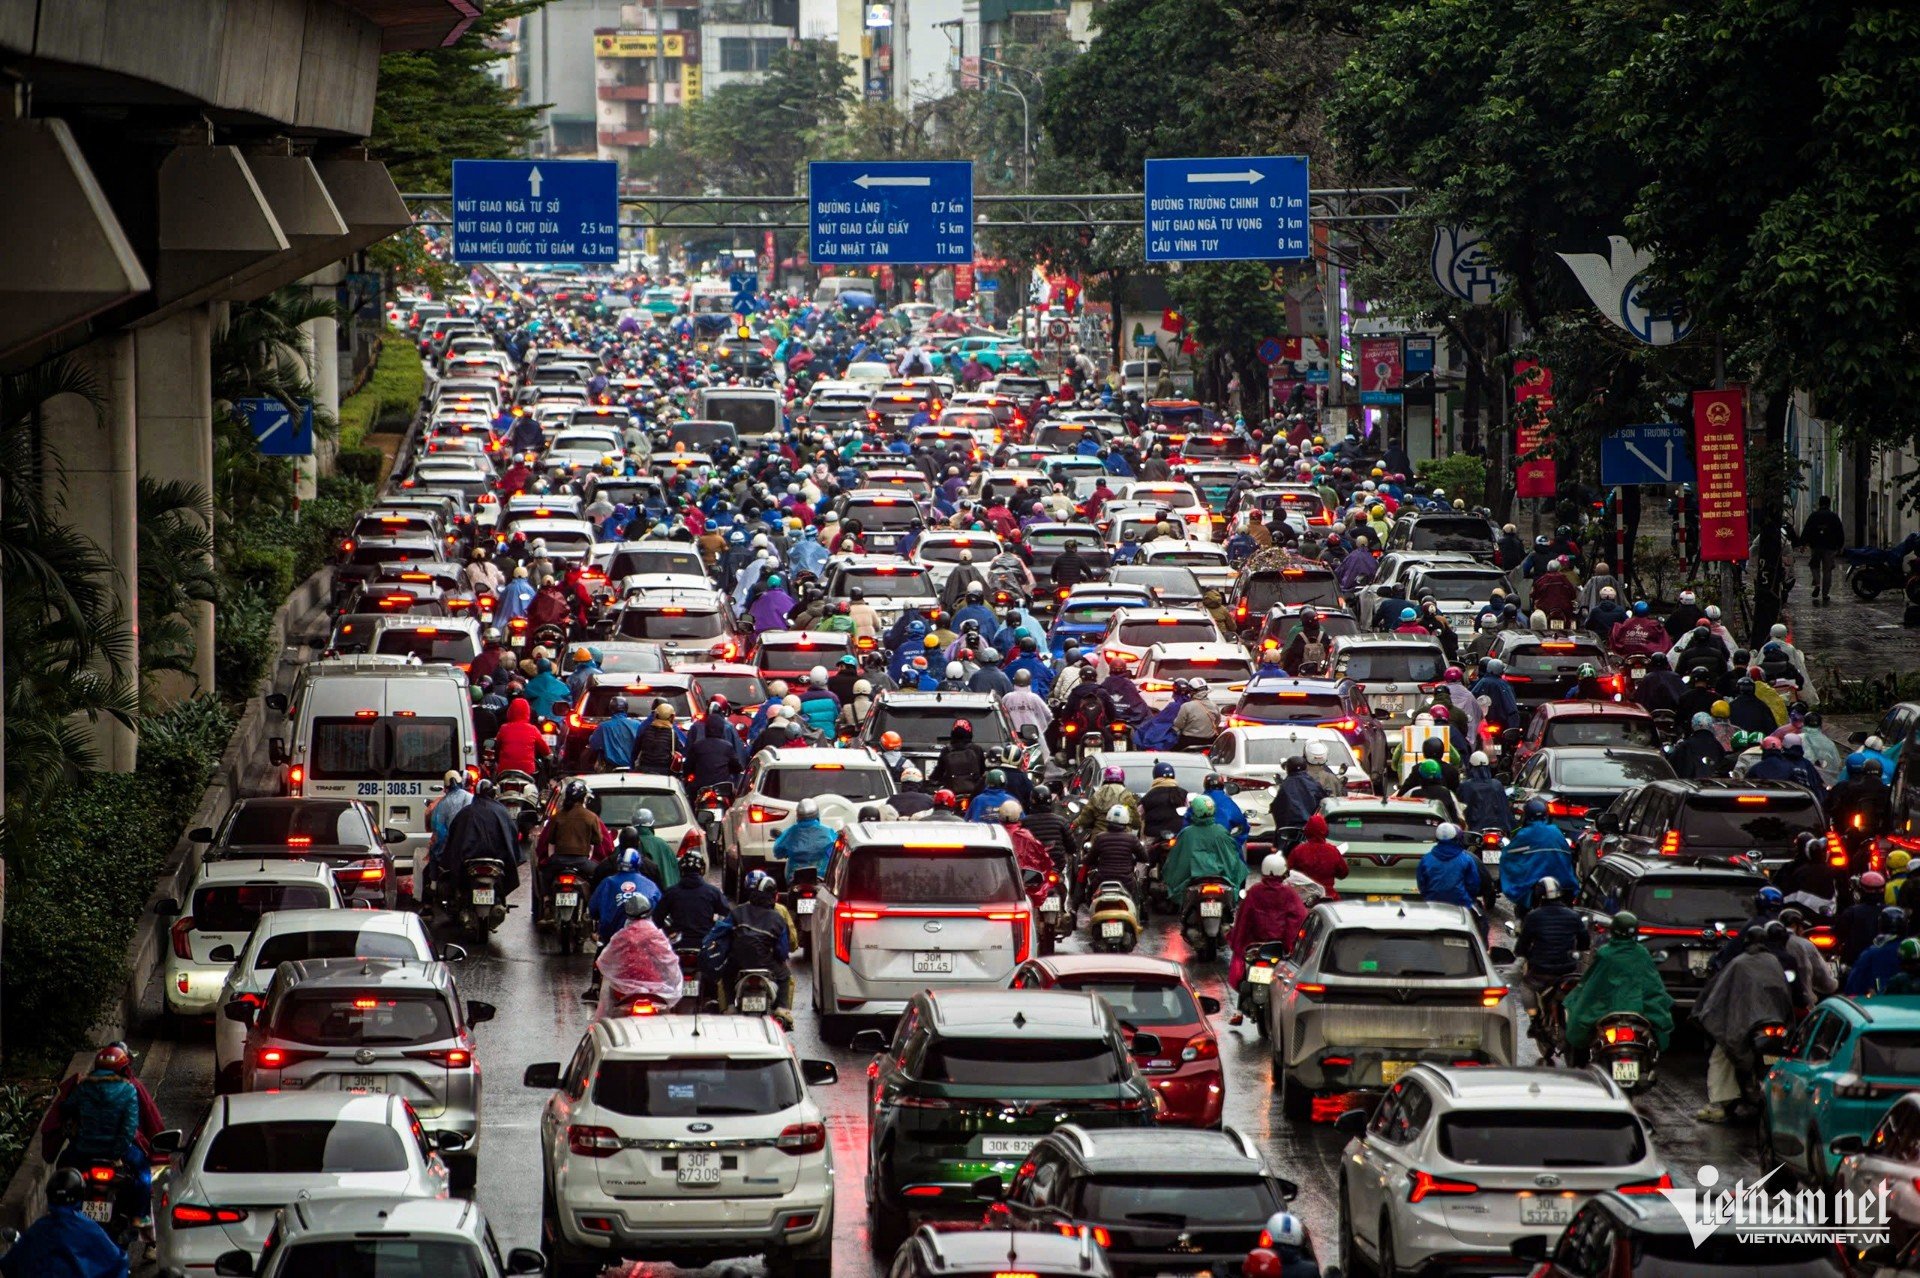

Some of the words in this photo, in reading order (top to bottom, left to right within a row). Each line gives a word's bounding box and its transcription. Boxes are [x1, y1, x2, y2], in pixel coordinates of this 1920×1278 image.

[457, 198, 476, 212] NÚT
[480, 200, 502, 212] GIAO
[530, 200, 542, 212] TƯ
[546, 198, 560, 213] SỞ
[818, 198, 850, 214] ĐƯỜNG
[854, 198, 880, 214] LÁNG
[931, 202, 945, 214] 0.7
[948, 202, 964, 214] km
[1151, 195, 1184, 211] ĐƯỜNG
[1188, 194, 1226, 210] TRƯỜNG
[1230, 197, 1258, 209] CHINH
[1269, 196, 1284, 208] 0.7
[1287, 196, 1302, 208] km
[458, 218, 477, 233] NÚT
[480, 221, 502, 234] GIAO
[516, 220, 535, 235] CHỢ
[539, 218, 559, 234] DỪA
[580, 222, 596, 234] 2.5
[598, 222, 614, 234] km
[818, 219, 836, 234] NÚT
[840, 222, 862, 234] GIAO
[866, 218, 884, 234] CẦU
[888, 218, 910, 234] GIẤY
[940, 222, 946, 234] 5
[948, 222, 964, 234] km
[1152, 216, 1170, 231] NÚT
[1173, 219, 1195, 231] GIAO
[1198, 216, 1217, 231] NGÃ
[1221, 218, 1233, 230] TƯ
[1236, 218, 1262, 232] VỌNG
[1278, 217, 1284, 229] 3
[1287, 217, 1302, 229] km
[458, 240, 478, 254] VĂN
[480, 238, 504, 254] MIẾU
[506, 238, 532, 254] QUỐC
[535, 239, 547, 254] TỬ
[550, 240, 575, 254] GIÁM
[599, 243, 614, 254] km
[818, 240, 837, 255] CẦU
[840, 241, 865, 256] NHẬT
[870, 241, 888, 255] TÂN
[936, 243, 946, 254] 11
[948, 243, 964, 254] km
[1152, 236, 1170, 252] CẦU
[1174, 237, 1197, 252] VĨNH
[1201, 239, 1219, 251] TUY
[1278, 238, 1284, 250] 8
[1287, 238, 1302, 249] km
[1052, 324, 1064, 334] 30
[357, 782, 382, 796] 29B-
[386, 782, 422, 796] 308.51
[924, 953, 941, 961] 30M
[918, 962, 948, 971] 001.45
[354, 1076, 374, 1086] 30H
[688, 1154, 710, 1167] 30F
[678, 1168, 719, 1182] 673.08
